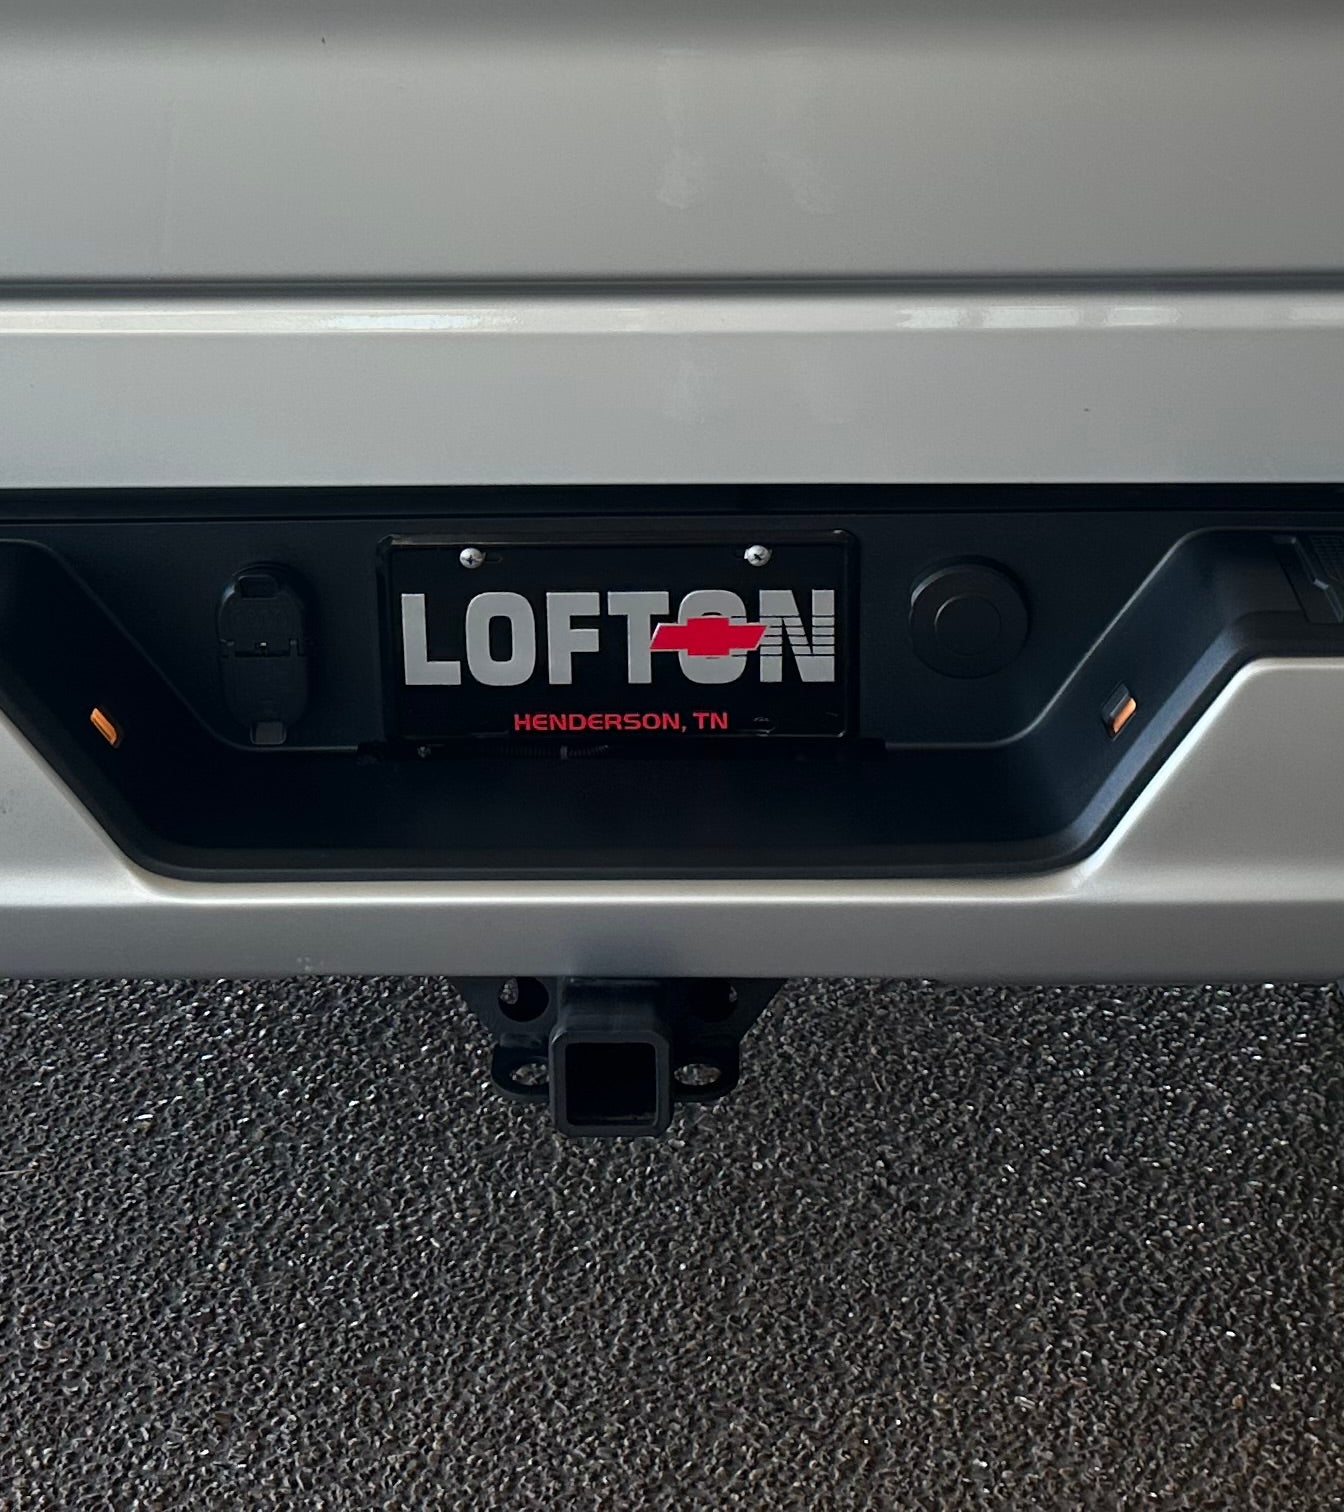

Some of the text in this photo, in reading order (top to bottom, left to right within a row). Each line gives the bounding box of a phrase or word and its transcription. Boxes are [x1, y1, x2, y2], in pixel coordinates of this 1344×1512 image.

[401, 589, 836, 687] LOFTON
[513, 711, 729, 733] HENDERSON, TN
